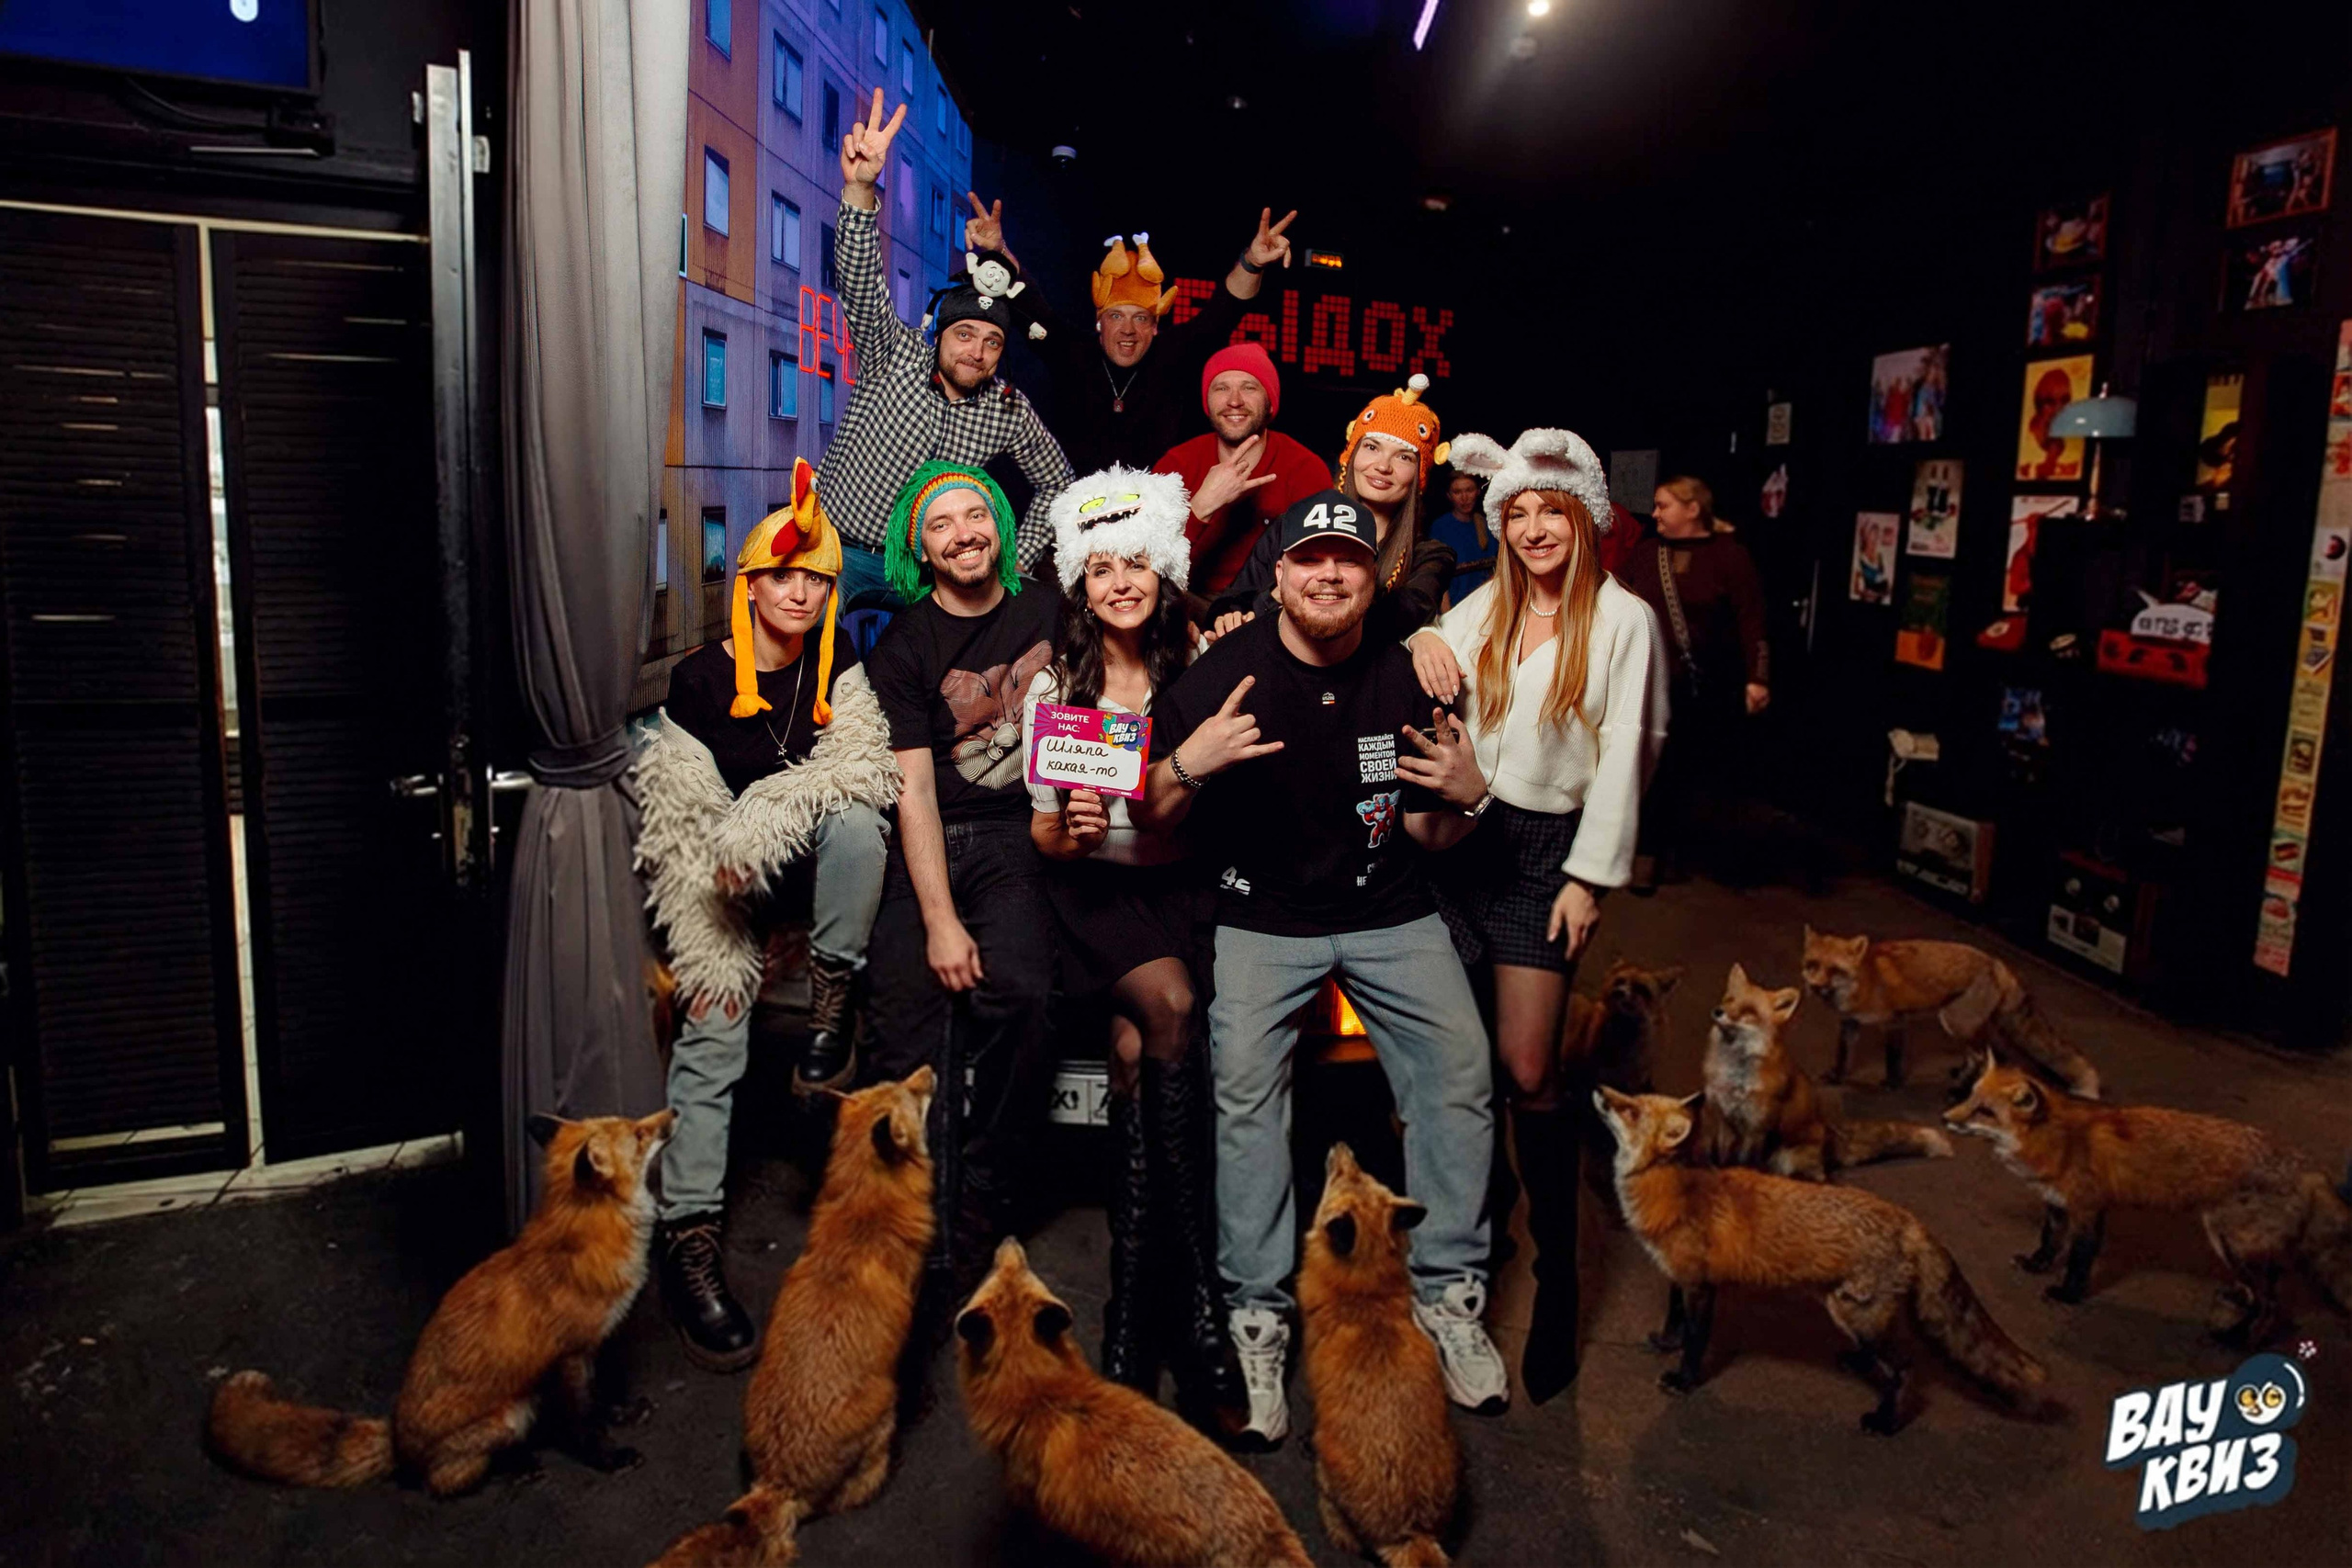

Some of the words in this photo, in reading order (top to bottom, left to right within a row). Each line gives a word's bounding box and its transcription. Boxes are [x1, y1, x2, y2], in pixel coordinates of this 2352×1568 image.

[1303, 502, 1357, 534] 42
[1050, 711, 1090, 724] ЗОВИТЕ
[1057, 722, 1080, 733] НАС:
[1109, 722, 1129, 735] ВАУ
[1114, 733, 1136, 743] КВИЗ
[1046, 739, 1108, 757] Шляпа
[1358, 740, 1395, 751] КАЖДЫМ
[1359, 750, 1396, 761] МОМЕНТОМ
[1046, 760, 1117, 777] какая-то
[1360, 758, 1396, 773] СВОЕЙ
[1361, 769, 1397, 784] ЖИЗНИ
